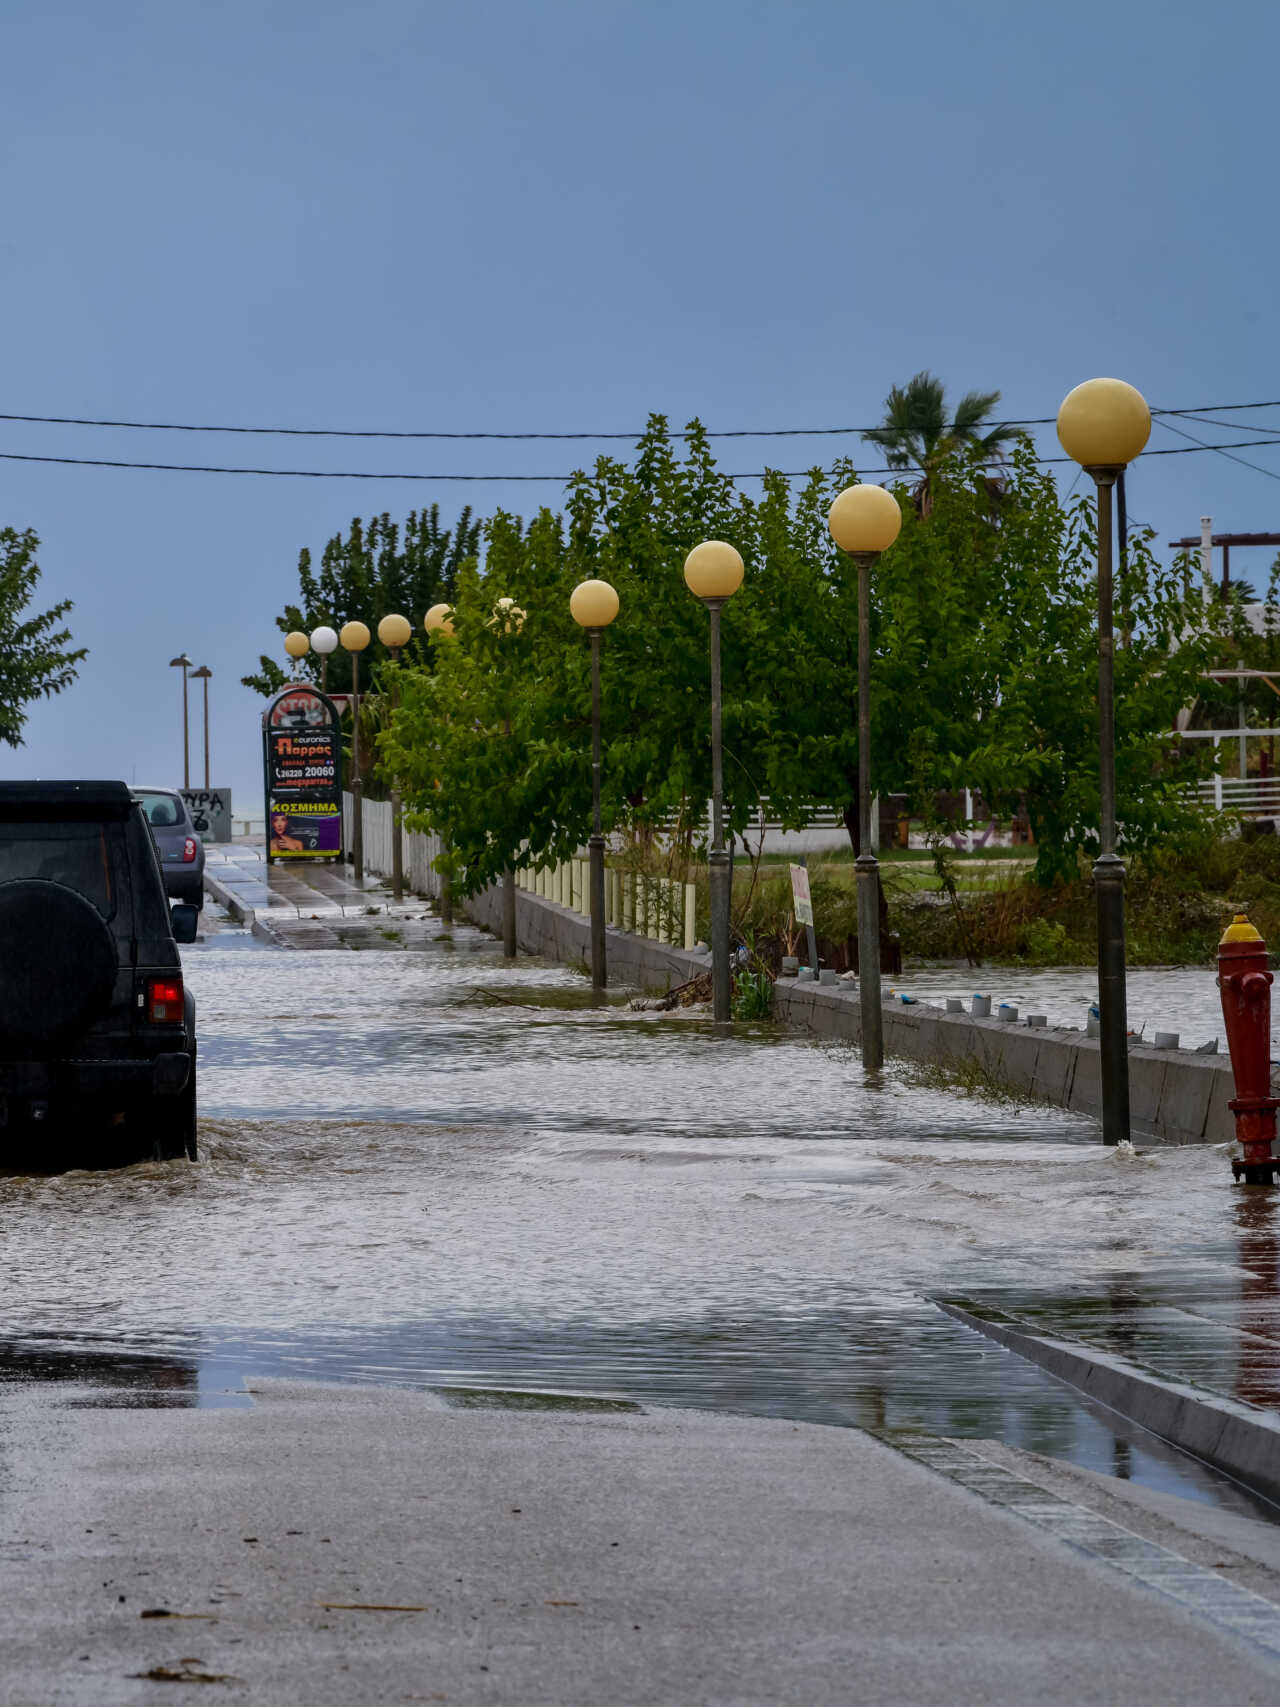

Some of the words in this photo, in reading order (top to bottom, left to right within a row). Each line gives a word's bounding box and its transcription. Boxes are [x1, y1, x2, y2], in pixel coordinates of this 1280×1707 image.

[276, 737, 332, 756] Παρράς
[305, 766, 335, 777] 20060
[271, 802, 338, 812] ΚΟΣΜΗΜΑ
